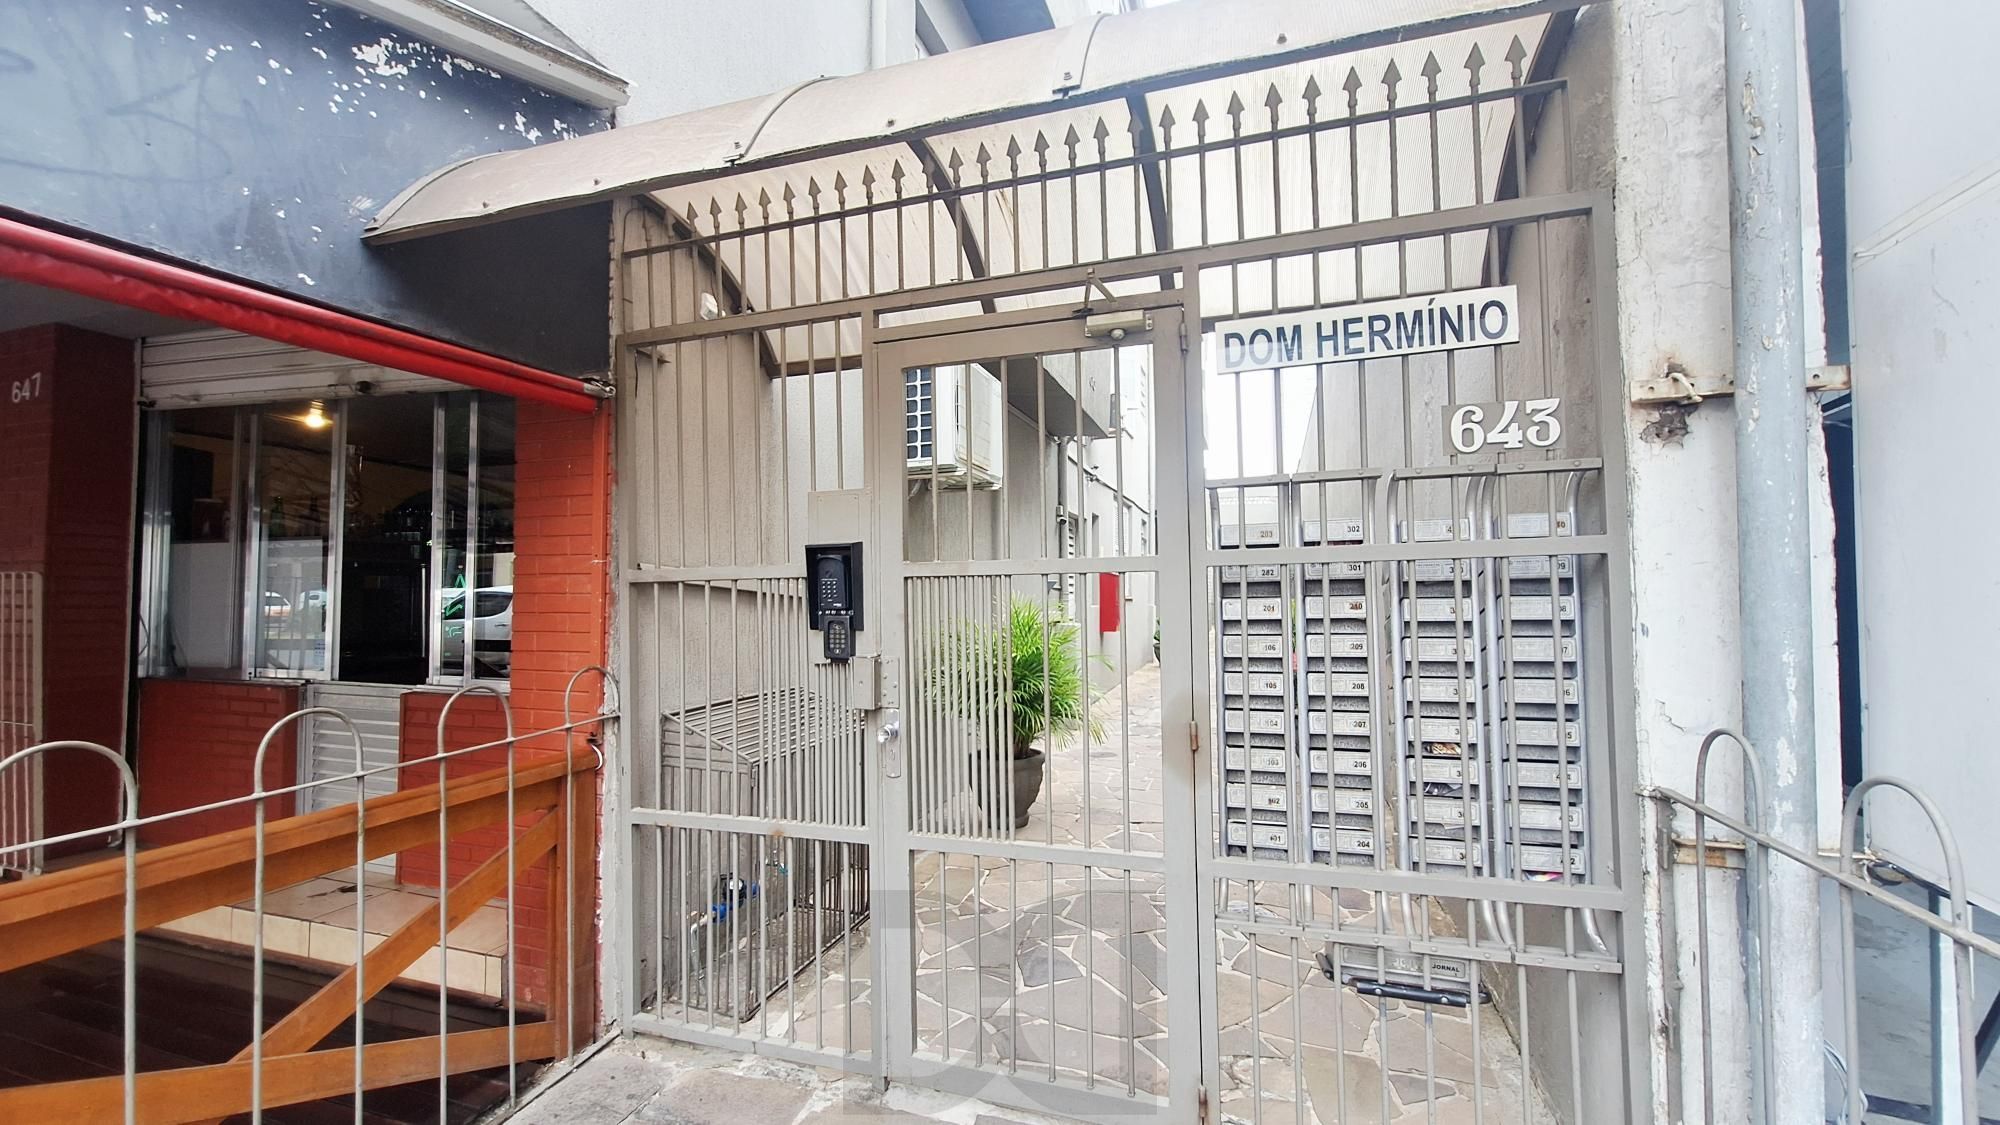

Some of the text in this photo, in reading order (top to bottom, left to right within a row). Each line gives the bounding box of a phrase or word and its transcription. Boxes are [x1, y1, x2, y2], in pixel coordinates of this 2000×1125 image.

[1225, 297, 1509, 368] DOM HERMÍNIO
[11, 371, 42, 404] 647
[1450, 397, 1562, 453] 643
[1347, 525, 1360, 533] 302
[1353, 761, 1367, 769] 206
[1356, 801, 1369, 809] 205
[1357, 840, 1371, 848] 204
[1432, 963, 1460, 973] JORNAL
